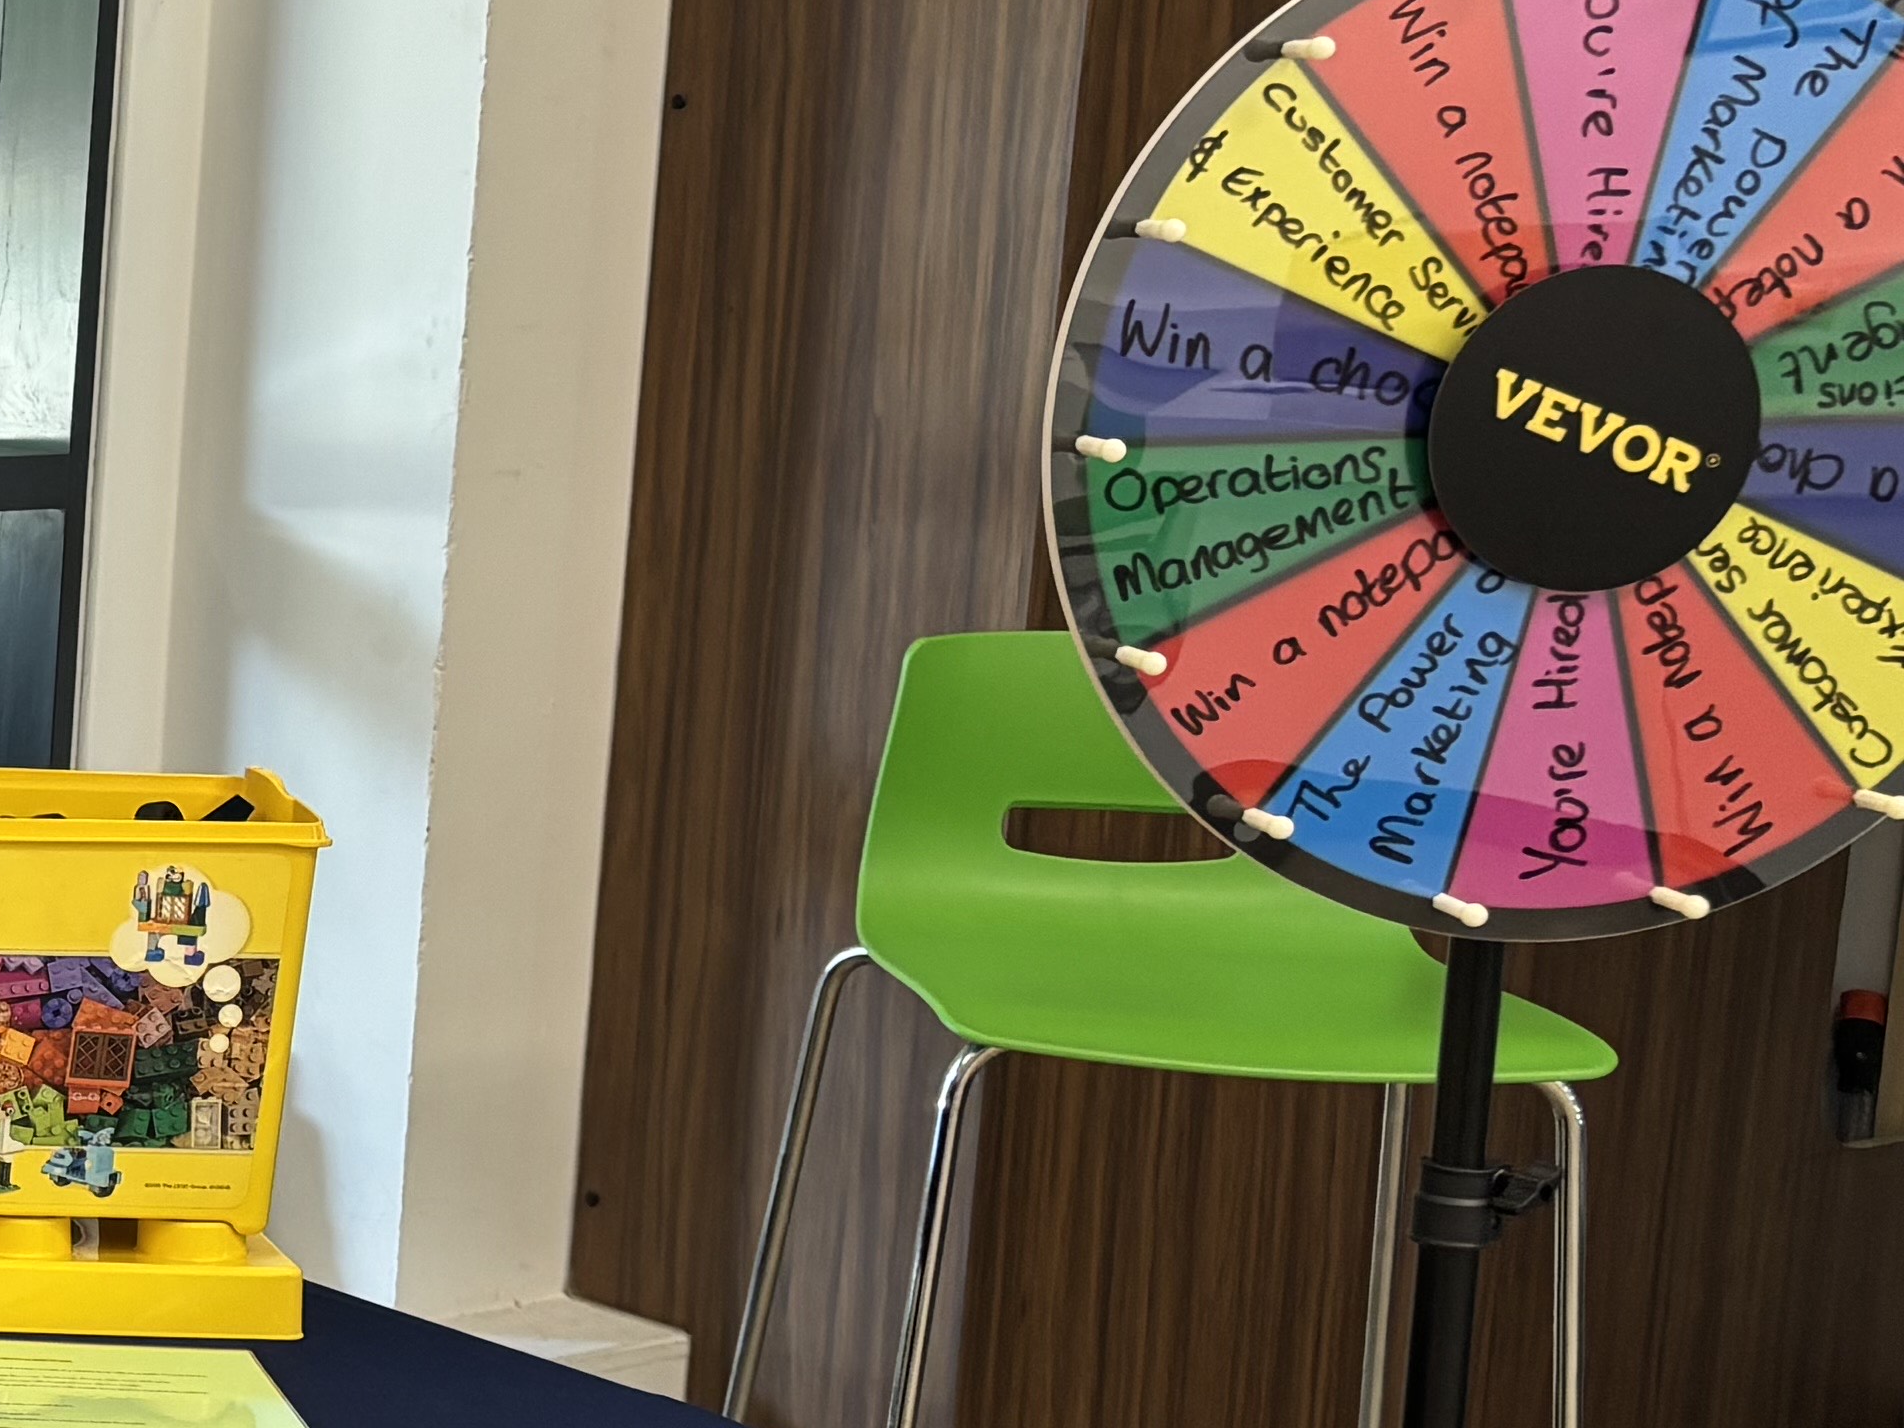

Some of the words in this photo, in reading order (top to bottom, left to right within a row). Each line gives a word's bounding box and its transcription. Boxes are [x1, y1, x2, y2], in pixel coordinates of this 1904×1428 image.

[1794, 19, 1877, 98] The
[1263, 82, 1404, 249] Customer
[1438, 103, 1467, 139] a
[1189, 129, 1228, 182] &
[1223, 168, 1406, 332] Experience
[1837, 197, 1871, 230] a
[1120, 299, 1212, 371] Win
[1240, 342, 1274, 383] a
[1104, 446, 1387, 513] Operations
[1493, 368, 1705, 493] VEVOR
[1869, 466, 1899, 502] a
[1115, 467, 1417, 601] Management
[1171, 675, 1255, 738] Win
[1273, 636, 1307, 664] a
[1532, 594, 1589, 710] Hired
[1746, 599, 1892, 768] Customer
[1288, 755, 1371, 821] The
[1358, 613, 1464, 733] Power
[1369, 631, 1517, 865] Marketing
[1684, 704, 1723, 741] a
[1519, 741, 1589, 880] You're
[1704, 754, 1773, 858] Win
